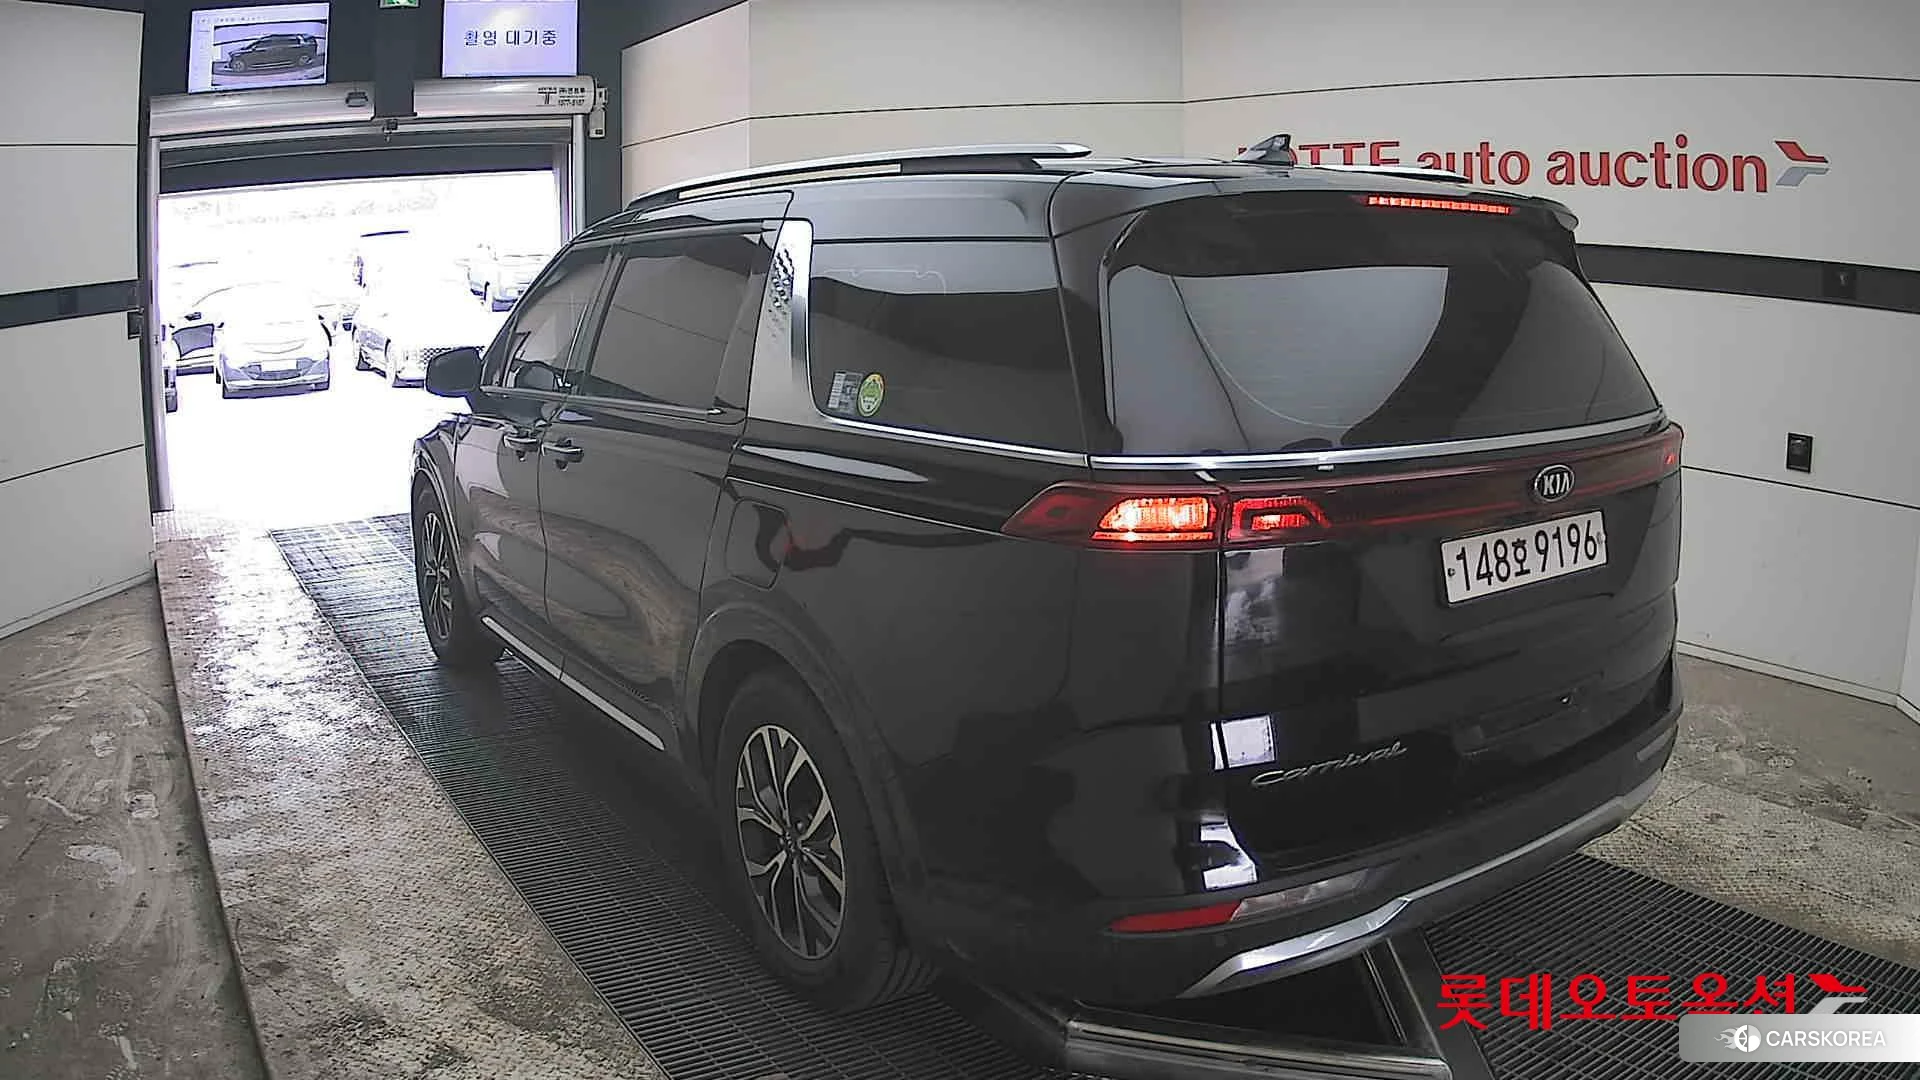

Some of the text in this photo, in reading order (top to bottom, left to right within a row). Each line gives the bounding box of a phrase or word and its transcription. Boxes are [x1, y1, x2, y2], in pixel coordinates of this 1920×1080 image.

[506, 29, 556, 46] 대기중
[1238, 134, 1767, 192] TTE auto auction
[1251, 741, 1407, 787] Carnival
